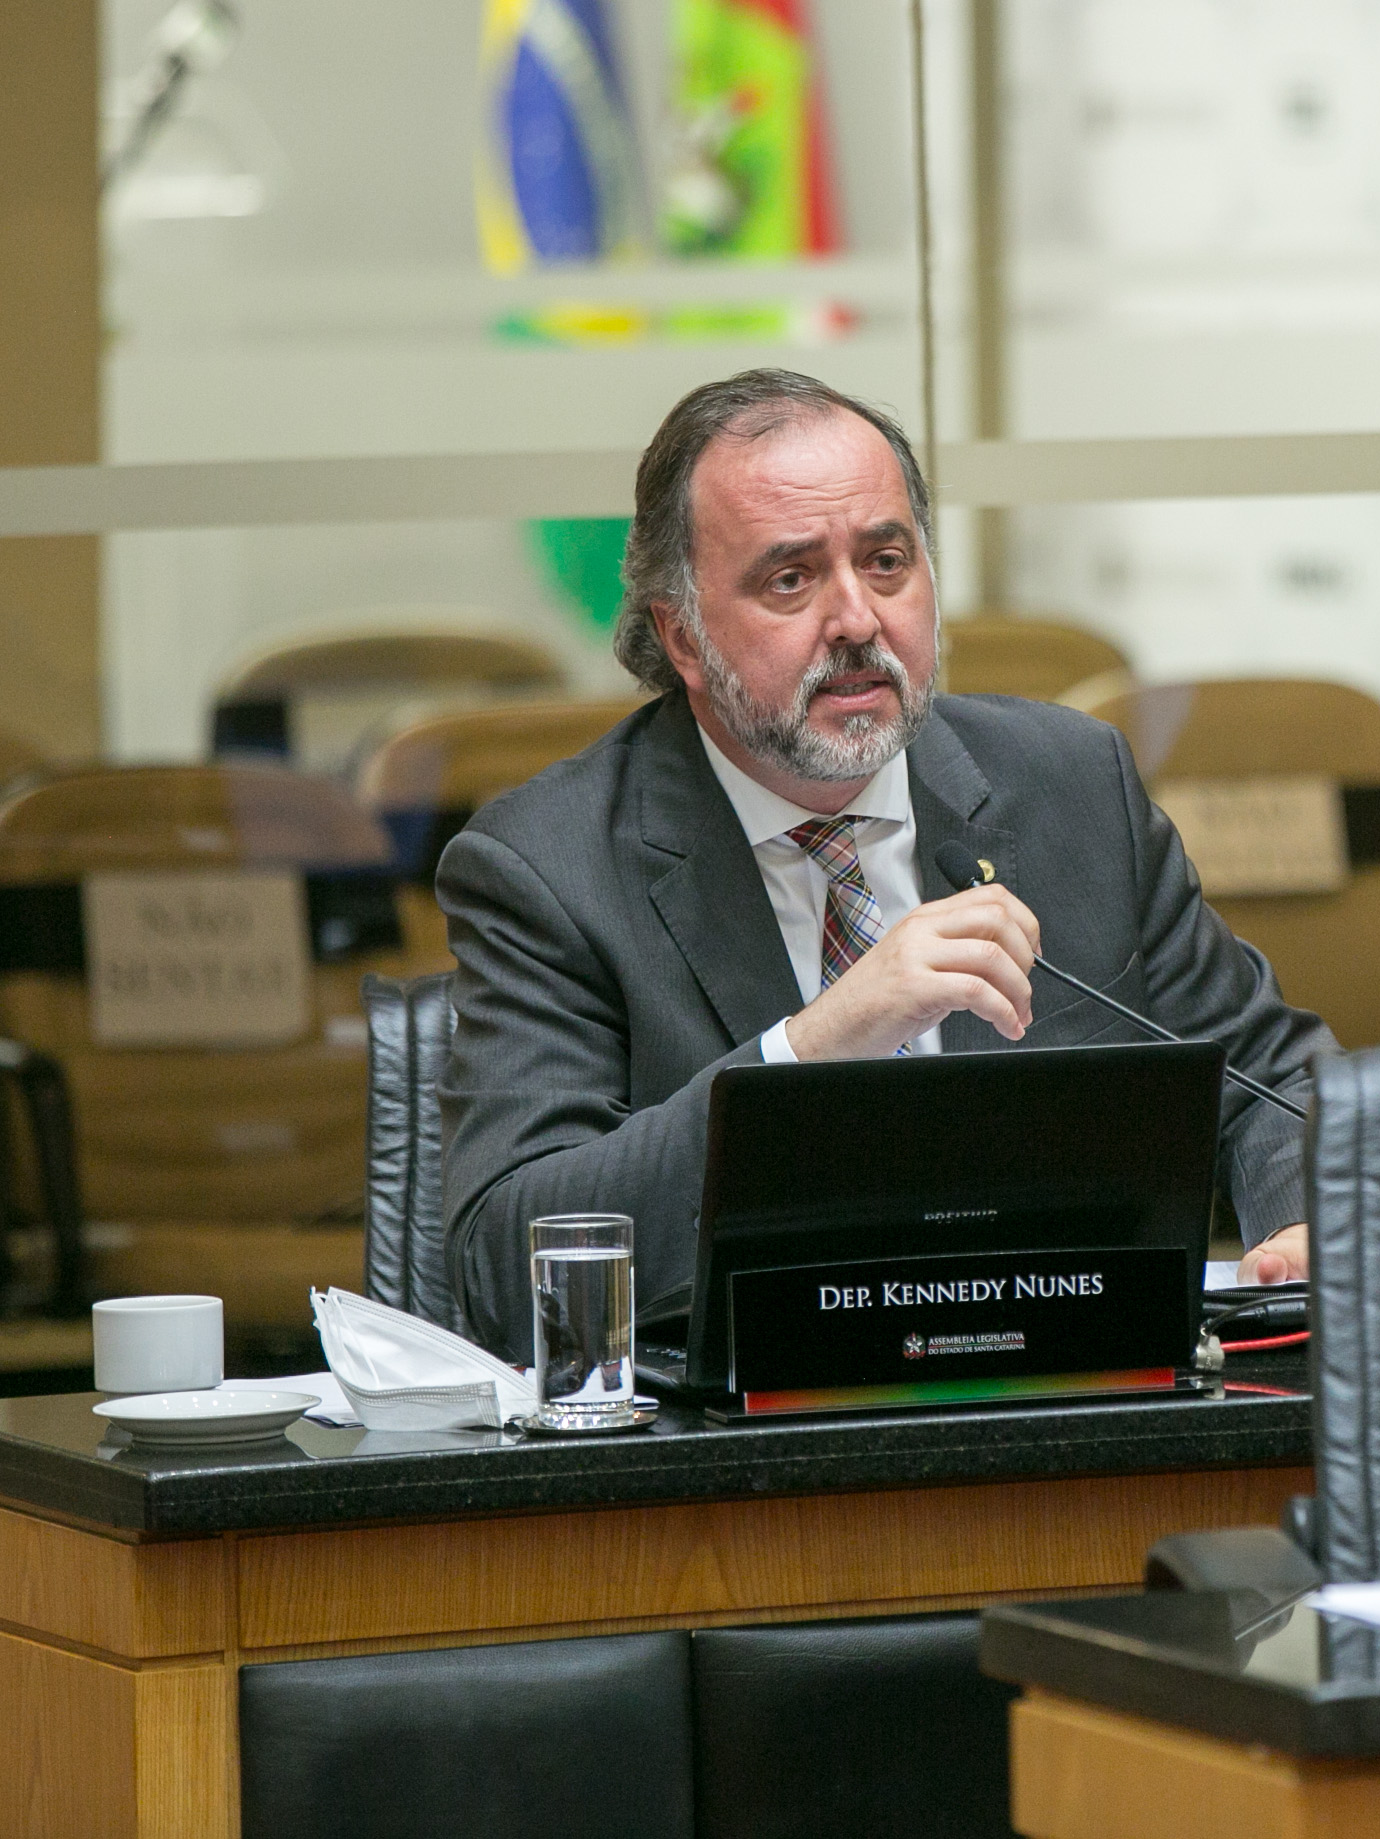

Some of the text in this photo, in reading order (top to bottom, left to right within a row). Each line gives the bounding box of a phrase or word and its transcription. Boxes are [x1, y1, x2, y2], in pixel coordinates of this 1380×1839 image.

[818, 1272, 1104, 1310] DEP. KENNEDY NUNES
[929, 1333, 1024, 1345] ASSEMBLEIA LEGISLATIVA
[940, 1346, 962, 1354] ESTADO
[964, 1345, 973, 1353] DE
[973, 1344, 994, 1352] SANTA
[995, 1343, 1025, 1351] CATARINA
